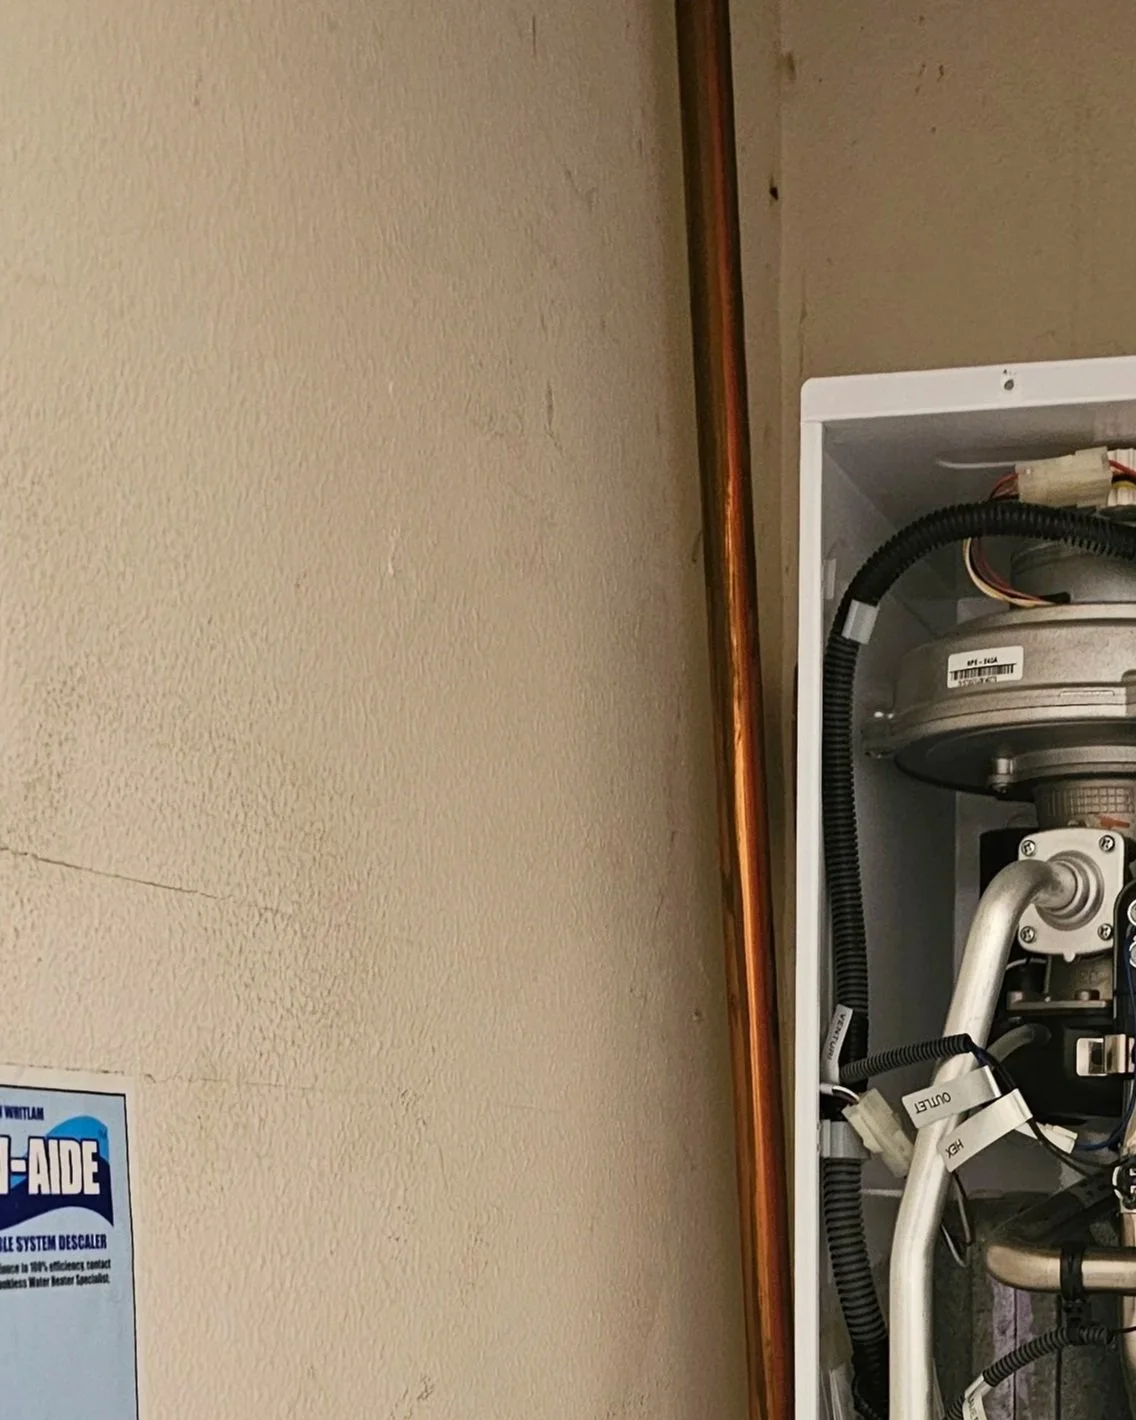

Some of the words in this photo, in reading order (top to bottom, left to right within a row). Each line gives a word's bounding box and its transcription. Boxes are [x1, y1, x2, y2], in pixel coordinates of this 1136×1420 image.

[914, 1091, 951, 1115] OUTLET
[4, 1105, 44, 1120] WHITLAM
[945, 1138, 964, 1158] HEX
[16, 1235, 56, 1252] SYSTEM
[58, 1233, 107, 1250] DESCALER
[86, 1258, 111, 1270] contact
[28, 1276, 50, 1288] Water
[51, 1275, 75, 1287] Heater
